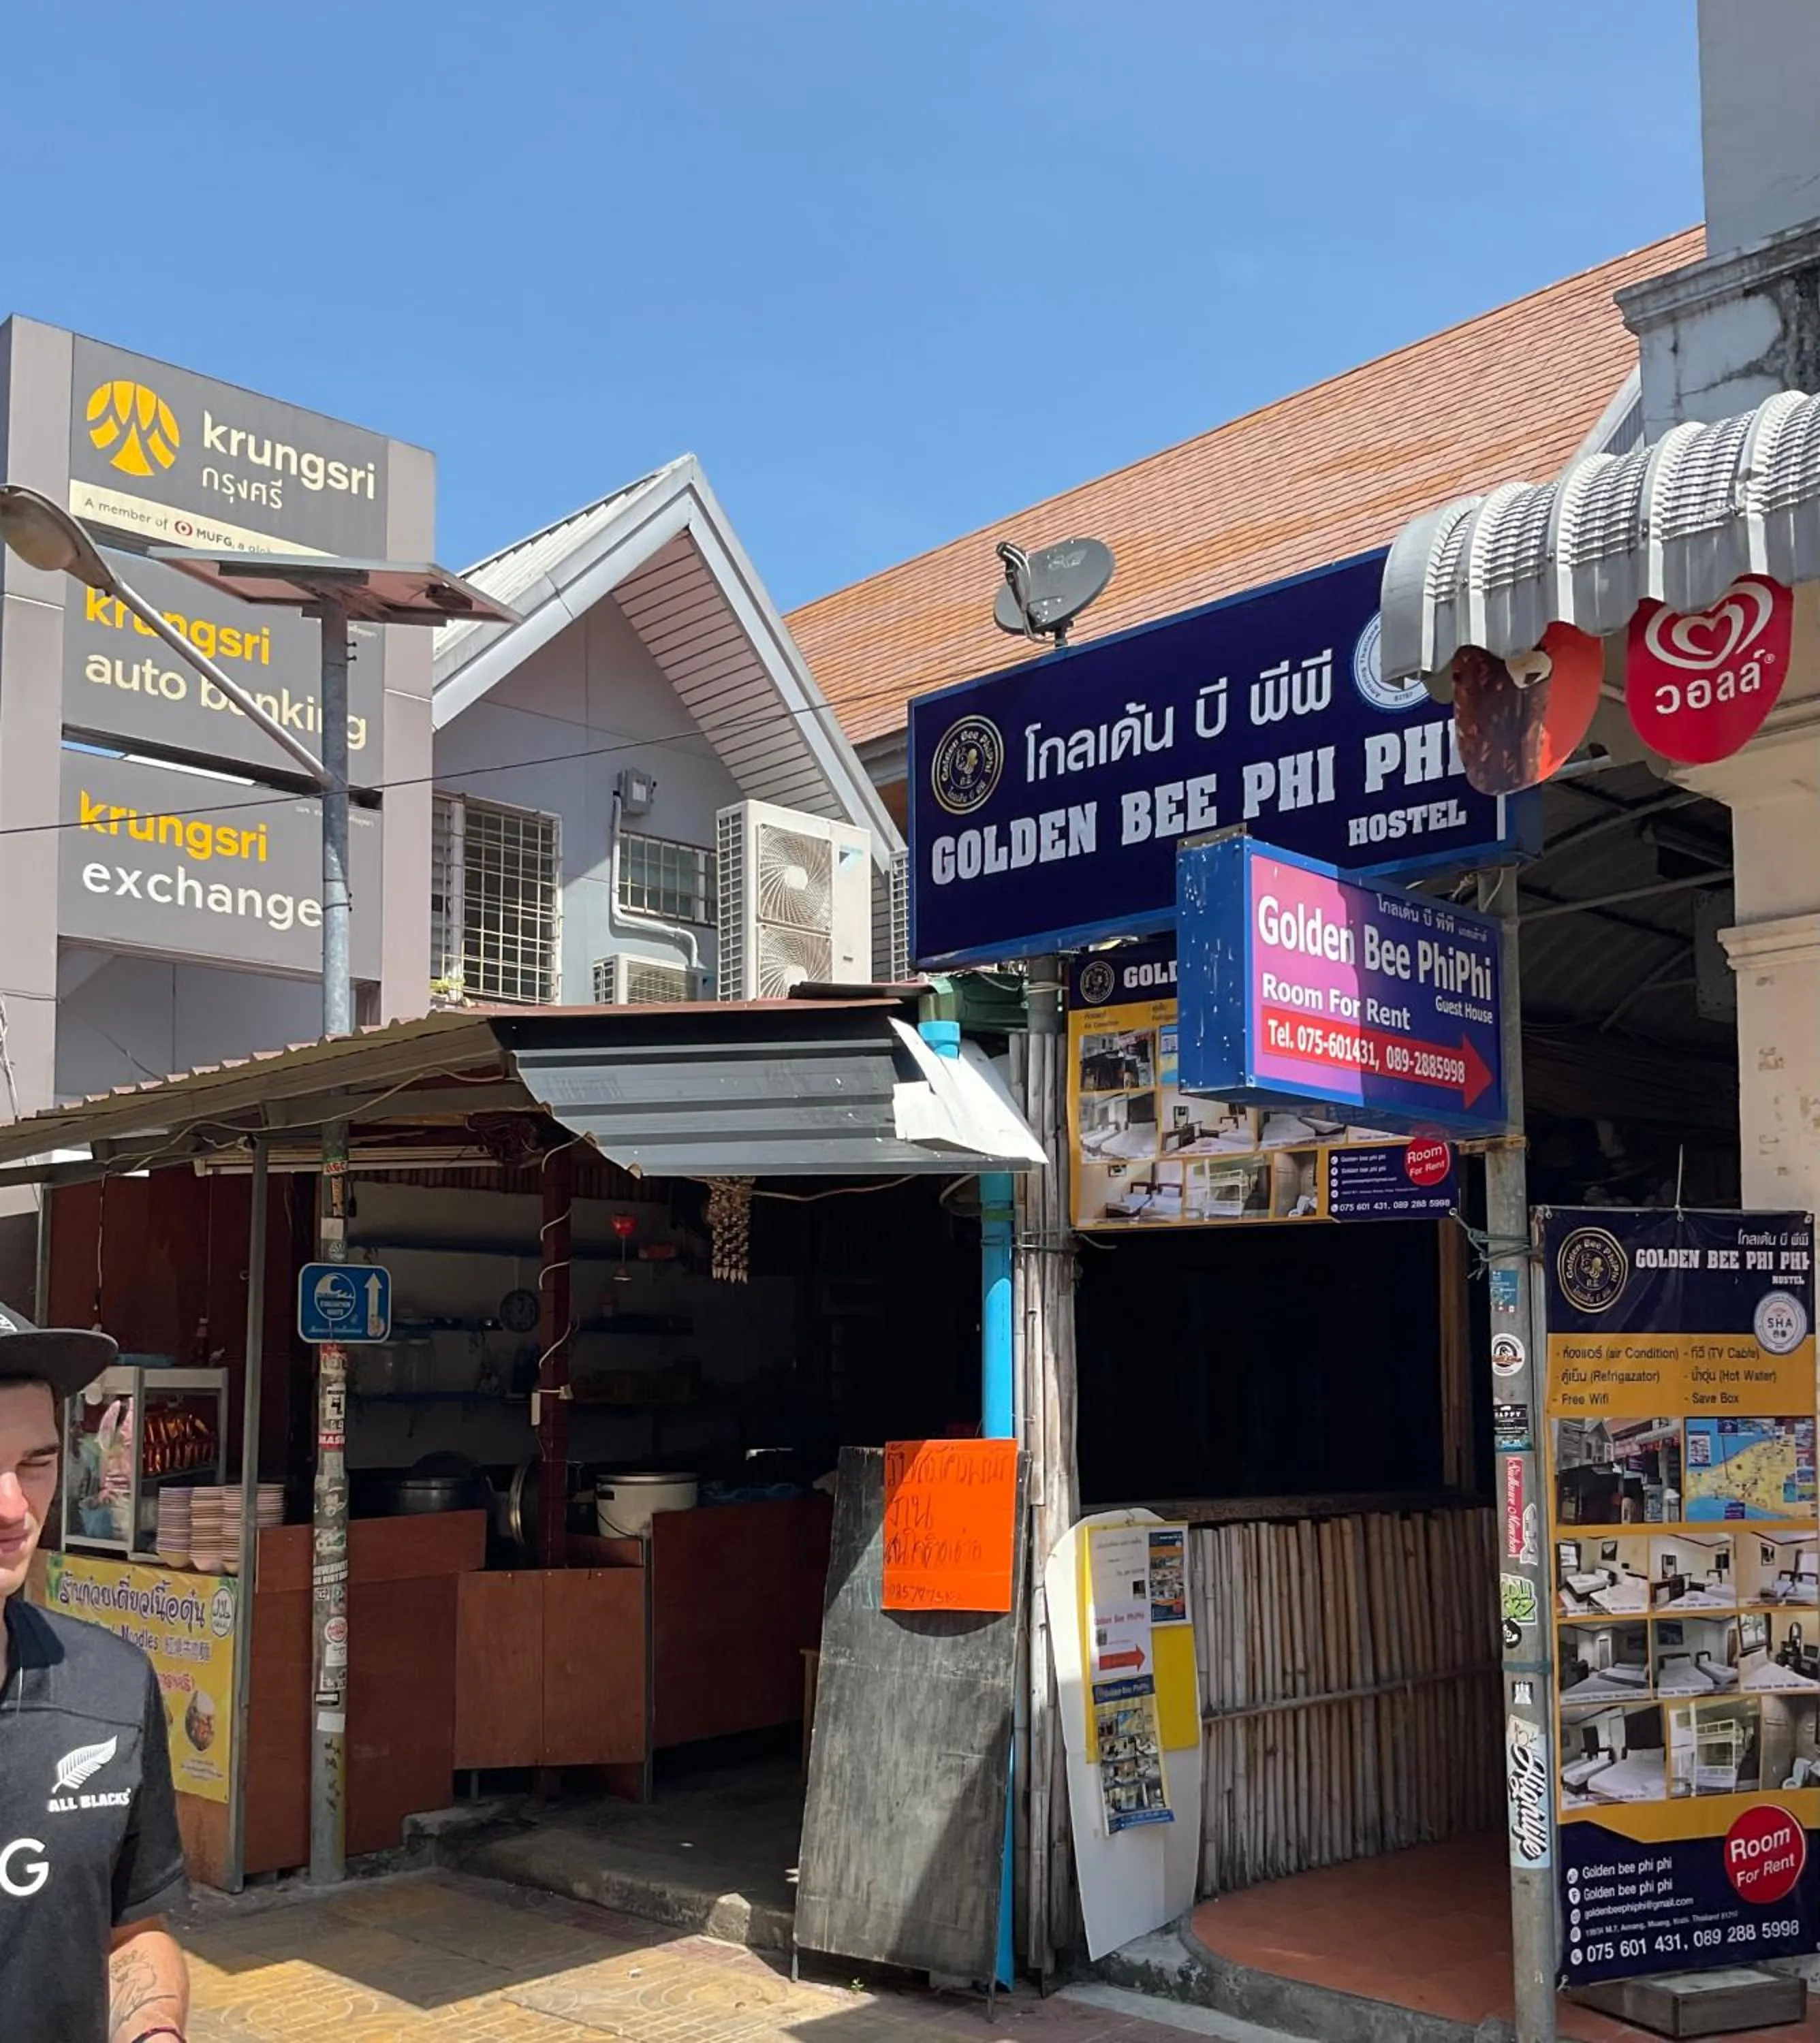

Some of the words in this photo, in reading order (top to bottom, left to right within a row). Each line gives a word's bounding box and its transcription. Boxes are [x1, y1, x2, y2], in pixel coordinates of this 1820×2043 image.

[204, 411, 375, 499] krungsri
[202, 466, 283, 510] กรุงศรี
[84, 498, 94, 508] A
[99, 502, 151, 524] member
[155, 518, 168, 530] of
[85, 654, 187, 700] auto
[1655, 649, 1766, 714] วอลล์
[1026, 701, 1174, 783] โกลเด้น
[1195, 676, 1227, 737] บี
[1249, 649, 1333, 725] พีพี
[80, 790, 267, 861] krungsri
[931, 802, 1097, 885] GOLDEN
[1120, 774, 1217, 846] BEE
[1242, 746, 1336, 819] PHI
[1348, 799, 1467, 848] HOSTEL
[82, 861, 322, 932] exchange
[1257, 894, 1355, 964] Golden
[1364, 923, 1411, 980] Bee
[1417, 939, 1492, 1002] PhiPhi
[1262, 972, 1323, 1011] Room
[1330, 989, 1361, 1018] For
[1366, 998, 1411, 1031] Rent
[1435, 996, 1462, 1017] Guest
[1464, 1003, 1493, 1024] House
[1268, 1019, 1294, 1049] Tel.
[1298, 1027, 1379, 1071] 075-601431,
[1386, 1045, 1465, 1083] 089-2885998
[1407, 1146, 1442, 1164] Room
[1409, 1167, 1423, 1177] For
[1426, 1160, 1445, 1172] Rent
[1340, 1203, 1354, 1211] 075
[1635, 1248, 1700, 1269] GOLDEN
[1707, 1250, 1740, 1269] BEE
[1746, 1251, 1773, 1269] PHI
[1772, 1275, 1804, 1285] HOSTEL
[1767, 1317, 1793, 1329] SHA
[1625, 1346, 1679, 1360] Condition)
[1562, 1393, 1585, 1405] Free
[1692, 1393, 1716, 1404] Save
[1721, 1393, 1739, 1404] Box
[48, 1796, 78, 1812] ALL
[80, 1792, 129, 1809] BLACKS
[1730, 1827, 1790, 1863] Room
[0, 1837, 49, 1897] G
[1582, 1864, 1615, 1880] Golden
[1618, 1863, 1635, 1875] bee
[1638, 1858, 1653, 1875] phi
[1657, 1856, 1672, 1873] phi
[1737, 1868, 1759, 1888] For
[1763, 1852, 1795, 1876] Rent
[1584, 1886, 1615, 1901] Golden
[1618, 1884, 1636, 1896] bee
[1639, 1880, 1654, 1896] phi
[1657, 1878, 1673, 1895] phi
[1586, 1942, 1614, 1962] 075
[1620, 1938, 1646, 1958] 601
[1654, 1933, 1689, 1952] 431,
[1693, 1929, 1721, 1948] 089
[1727, 1924, 1757, 1943] 288
[1762, 1920, 1800, 1939] 5998
